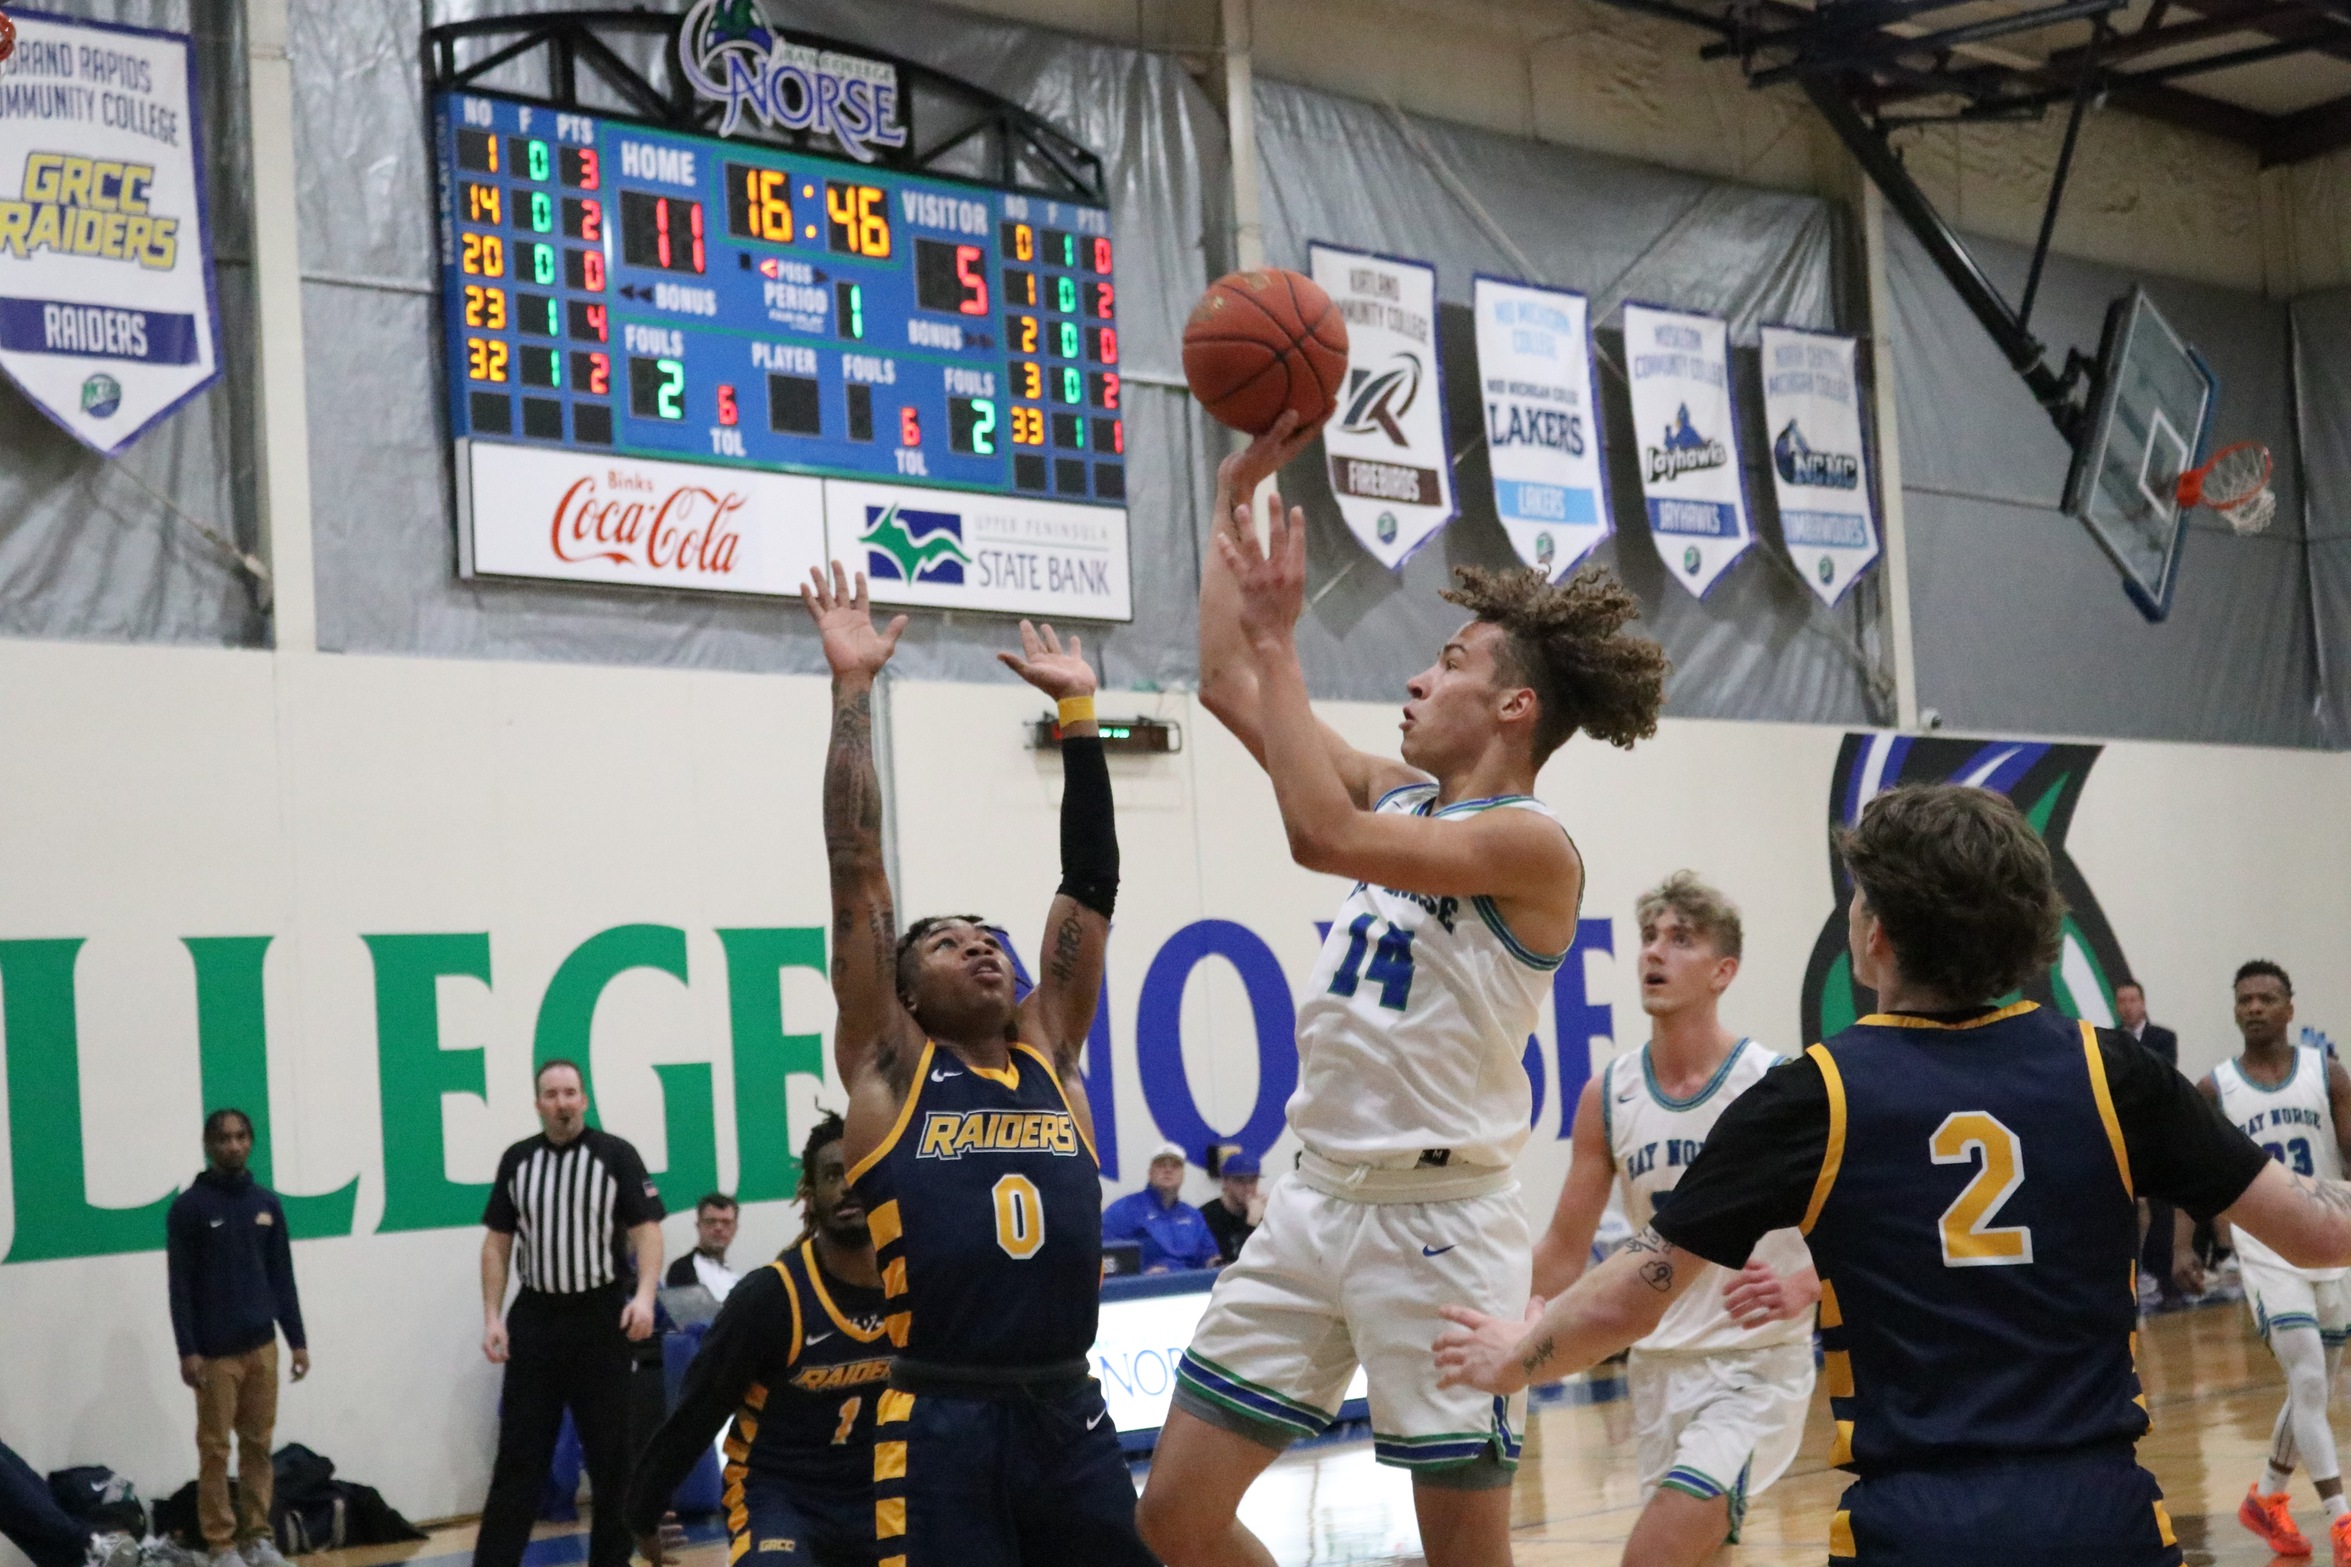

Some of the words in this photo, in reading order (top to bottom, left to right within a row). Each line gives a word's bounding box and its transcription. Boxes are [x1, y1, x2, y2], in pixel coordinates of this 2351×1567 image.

[80, 45, 153, 95] RAPIDS
[102, 90, 179, 148] COLLEGE
[464, 99, 493, 126] NO
[519, 107, 533, 133] F
[556, 114, 593, 144] PTS
[719, 51, 907, 162] NORSE
[22, 151, 155, 213] GRCC
[487, 134, 498, 172] 1
[528, 139, 550, 182] 0
[578, 148, 599, 191] 3
[621, 141, 697, 187] HOME
[0, 203, 179, 270] RAIDERS
[469, 183, 501, 225] 14
[531, 191, 553, 234] 0
[581, 199, 602, 242] 2
[655, 197, 705, 273] 11
[746, 168, 891, 258] 16:46
[901, 190, 989, 236] VISITOR
[462, 232, 504, 277] 20
[533, 242, 555, 285] 0
[583, 249, 605, 293] 0
[1015, 223, 1034, 262] 0
[1063, 234, 1074, 267] 1
[1094, 237, 1113, 275] 0
[655, 283, 718, 316] BONUS
[764, 281, 828, 314] PERIOD
[956, 244, 989, 316] 5
[1026, 273, 1037, 306] 1
[1058, 276, 1076, 314] 0
[1097, 281, 1115, 319] 2
[44, 305, 148, 357] RAIDERS
[465, 285, 507, 330] 23
[547, 297, 559, 337] 1
[586, 304, 608, 343] 4
[850, 284, 863, 339] 1
[908, 319, 962, 351] BONUS
[624, 325, 684, 358] FOULS
[752, 341, 817, 374] PLAYER
[1020, 315, 1038, 353] 2
[1060, 321, 1079, 359] 0
[1099, 327, 1119, 365] 0
[468, 337, 509, 383] 32
[550, 349, 561, 388] 1
[589, 352, 610, 395] 2
[656, 358, 685, 420] 2
[842, 353, 896, 385] FOULS
[944, 368, 995, 397] FOULS
[1023, 361, 1042, 400] 3
[1063, 366, 1082, 405] 0
[1102, 371, 1121, 410] 2
[717, 385, 737, 426] 6
[901, 407, 920, 447] 6
[970, 398, 996, 455] 2
[1011, 406, 1044, 446] 33
[1075, 417, 1084, 448] 1
[1113, 419, 1124, 454] 1
[710, 427, 747, 457] TOL
[1487, 403, 1586, 459] LAKERS
[607, 470, 654, 492] Binks
[894, 449, 928, 476] TOL
[978, 549, 1042, 589] STATE
[1048, 556, 1111, 595] BANK
[1327, 912, 1416, 1012] 14
[916, 1108, 1078, 1160] RAIDERS
[1627, 1142, 1658, 1181] BAY
[1666, 1138, 1705, 1168] NO
[1928, 1110, 2034, 1268] 2
[992, 1173, 1046, 1260] 0
[831, 1396, 862, 1445] 1
